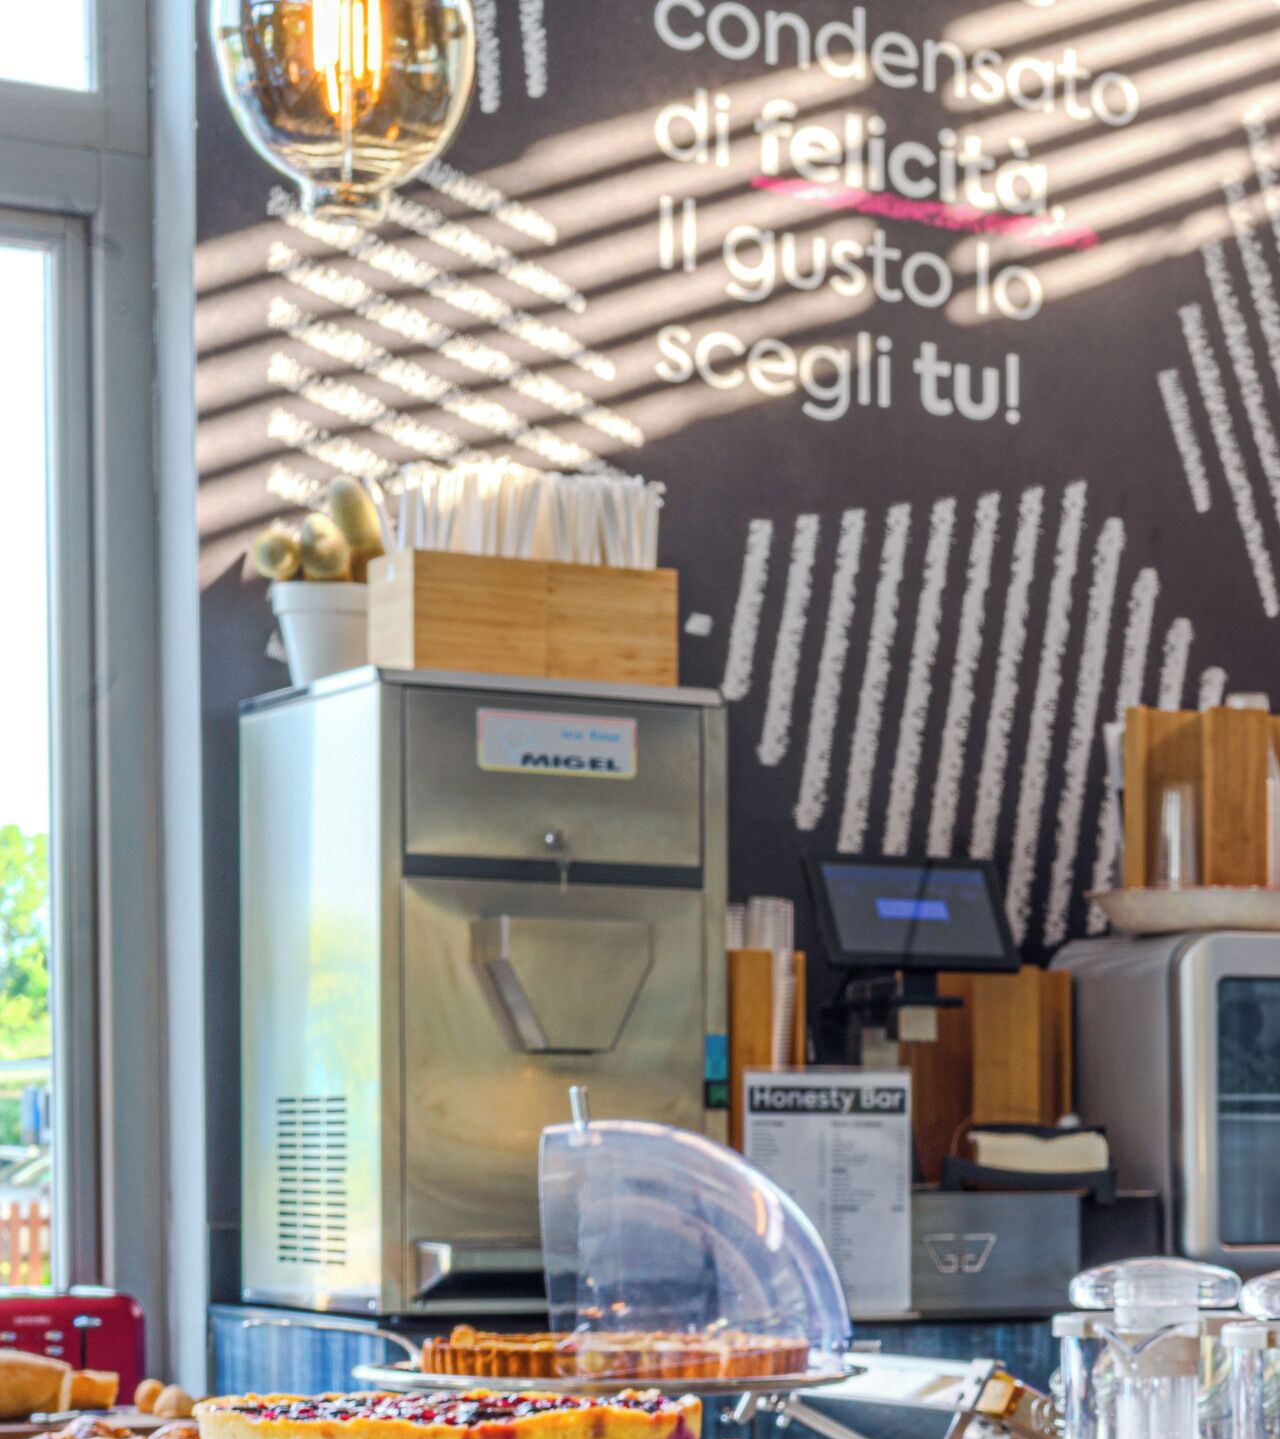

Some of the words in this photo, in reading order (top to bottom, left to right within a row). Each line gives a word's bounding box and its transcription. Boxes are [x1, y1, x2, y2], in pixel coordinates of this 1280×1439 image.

[654, 0, 1139, 127] condensato
[654, 88, 731, 168] di
[723, 225, 953, 308] gusto
[974, 242, 1044, 320] lo
[655, 326, 893, 421] scegli
[913, 341, 1021, 425] tu!
[520, 751, 623, 772] MIGEL
[752, 1086, 855, 1114] Honesty
[861, 1085, 904, 1110] Bar
